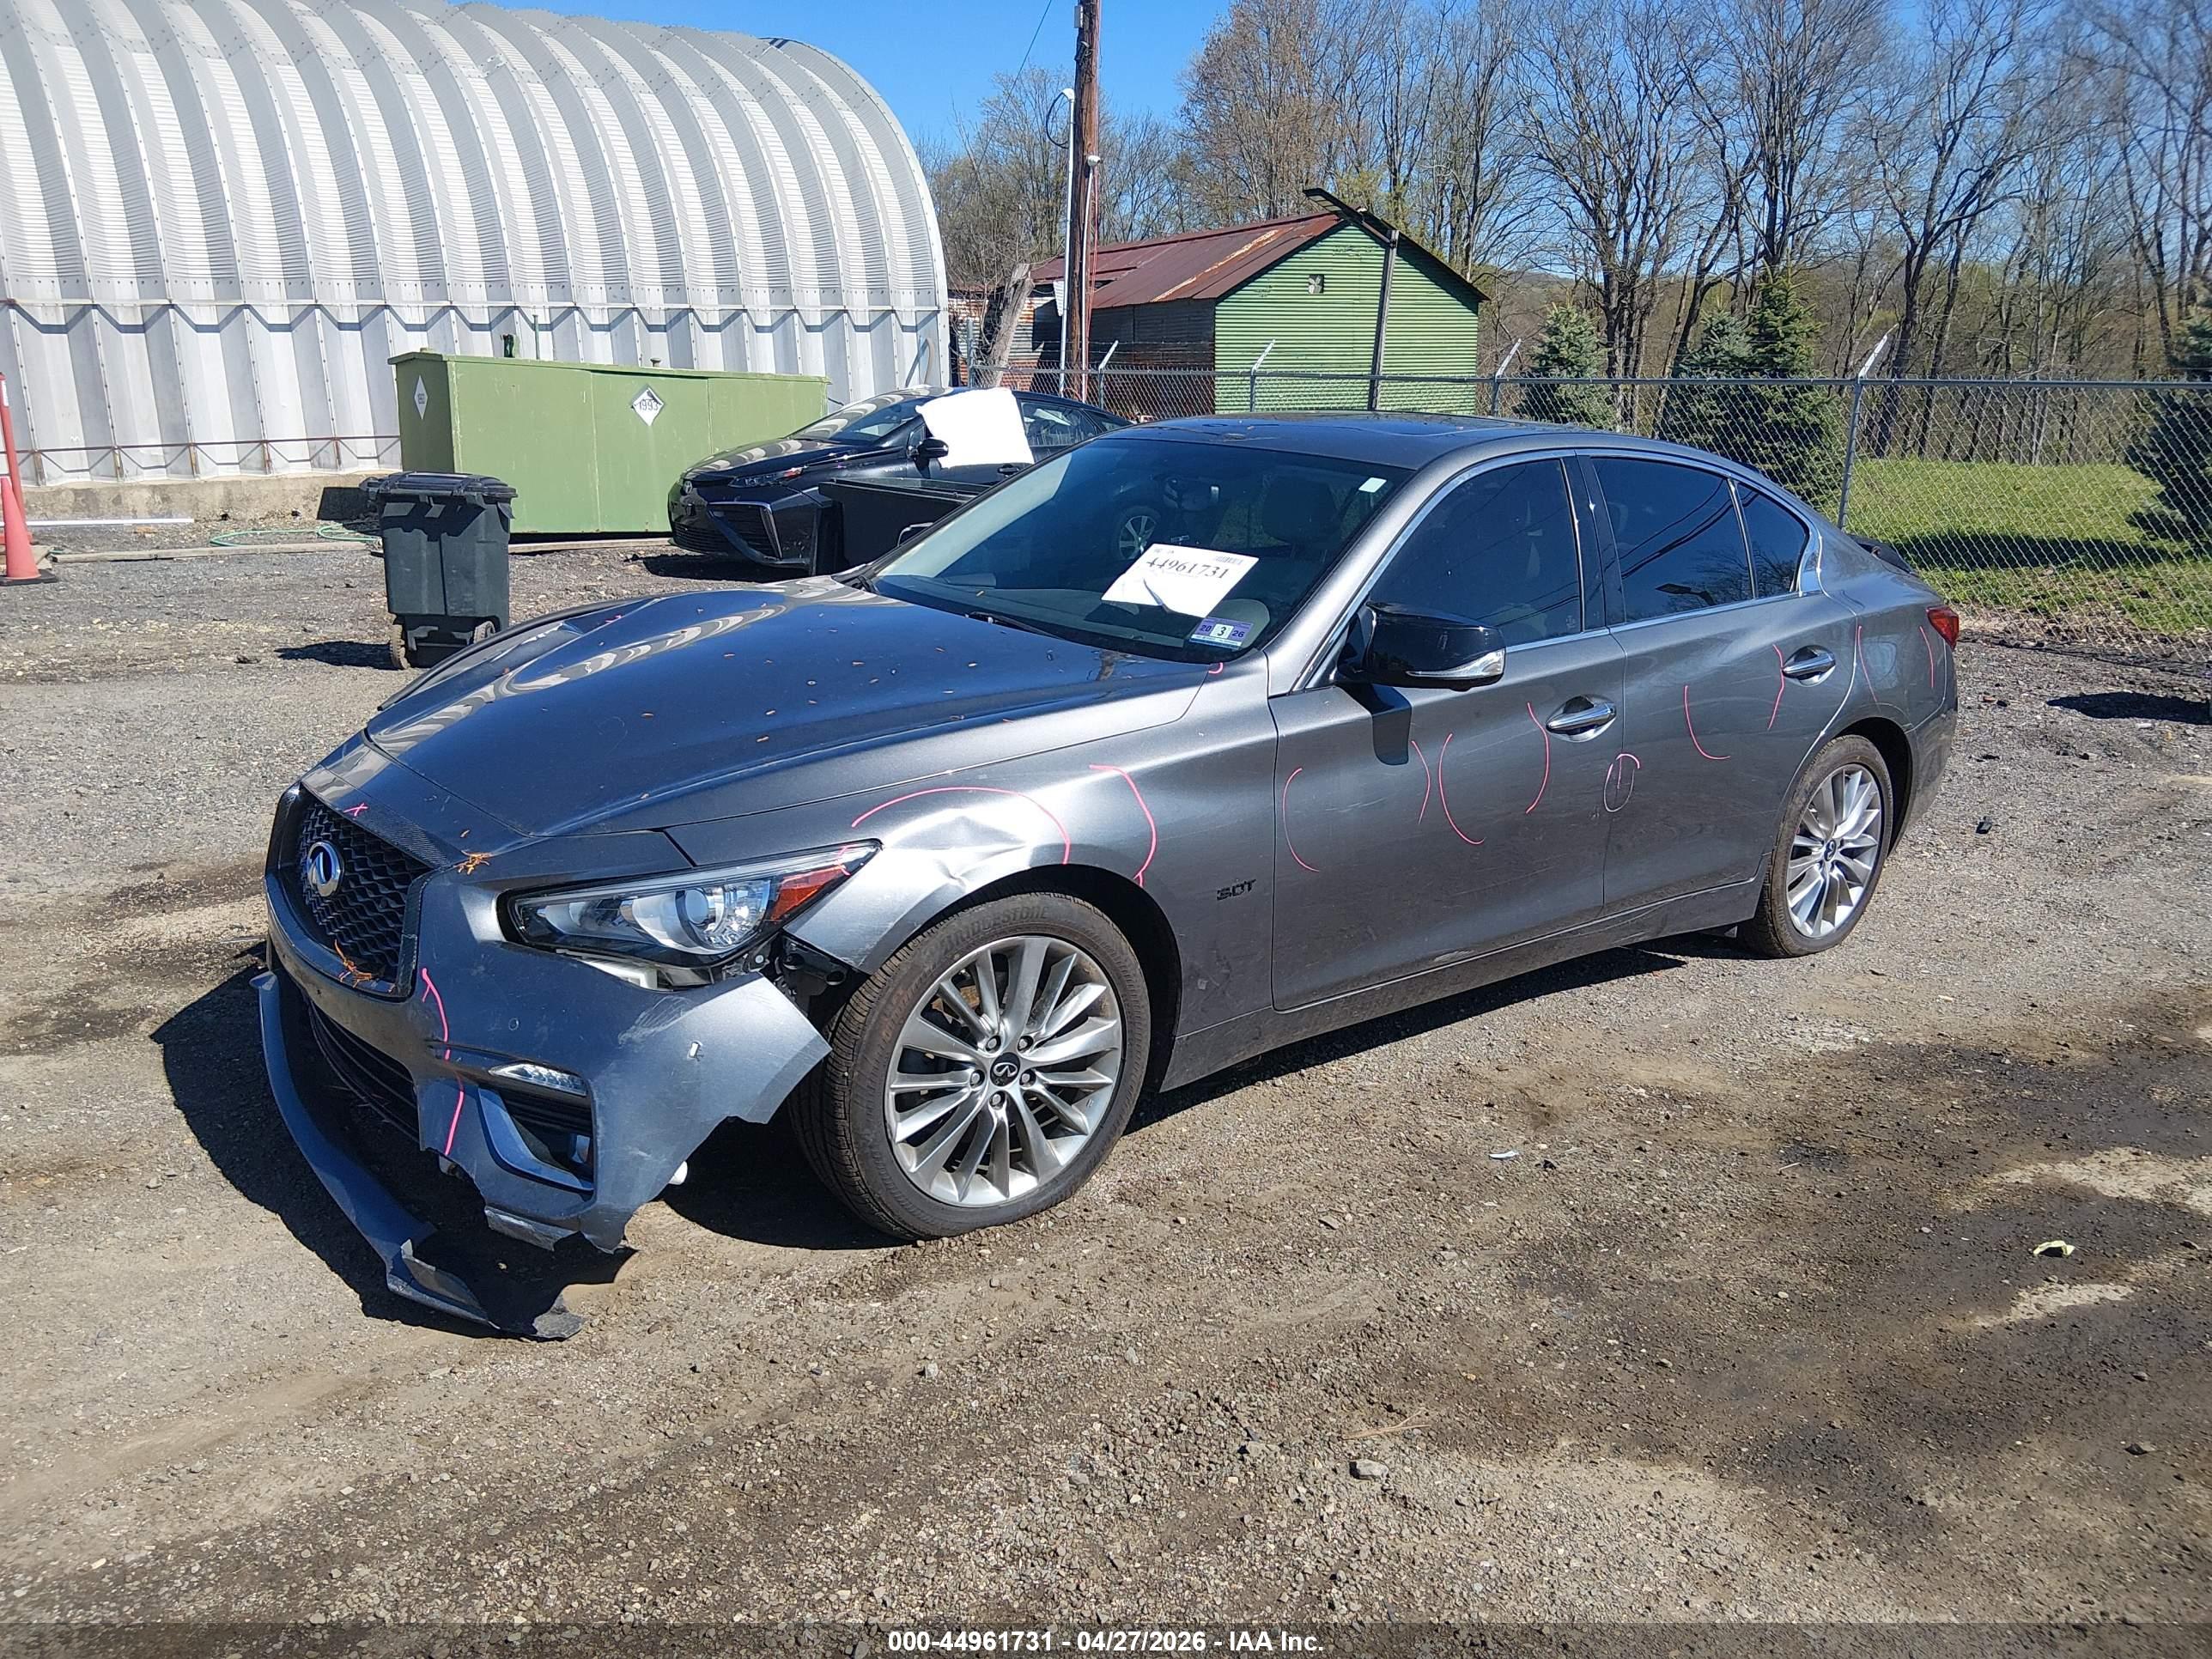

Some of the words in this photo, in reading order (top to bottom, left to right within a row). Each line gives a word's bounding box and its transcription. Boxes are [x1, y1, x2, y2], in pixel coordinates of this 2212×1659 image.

[639, 398, 659, 411] 1993
[1146, 557, 1229, 579] 44961731
[1217, 626, 1227, 636] 3
